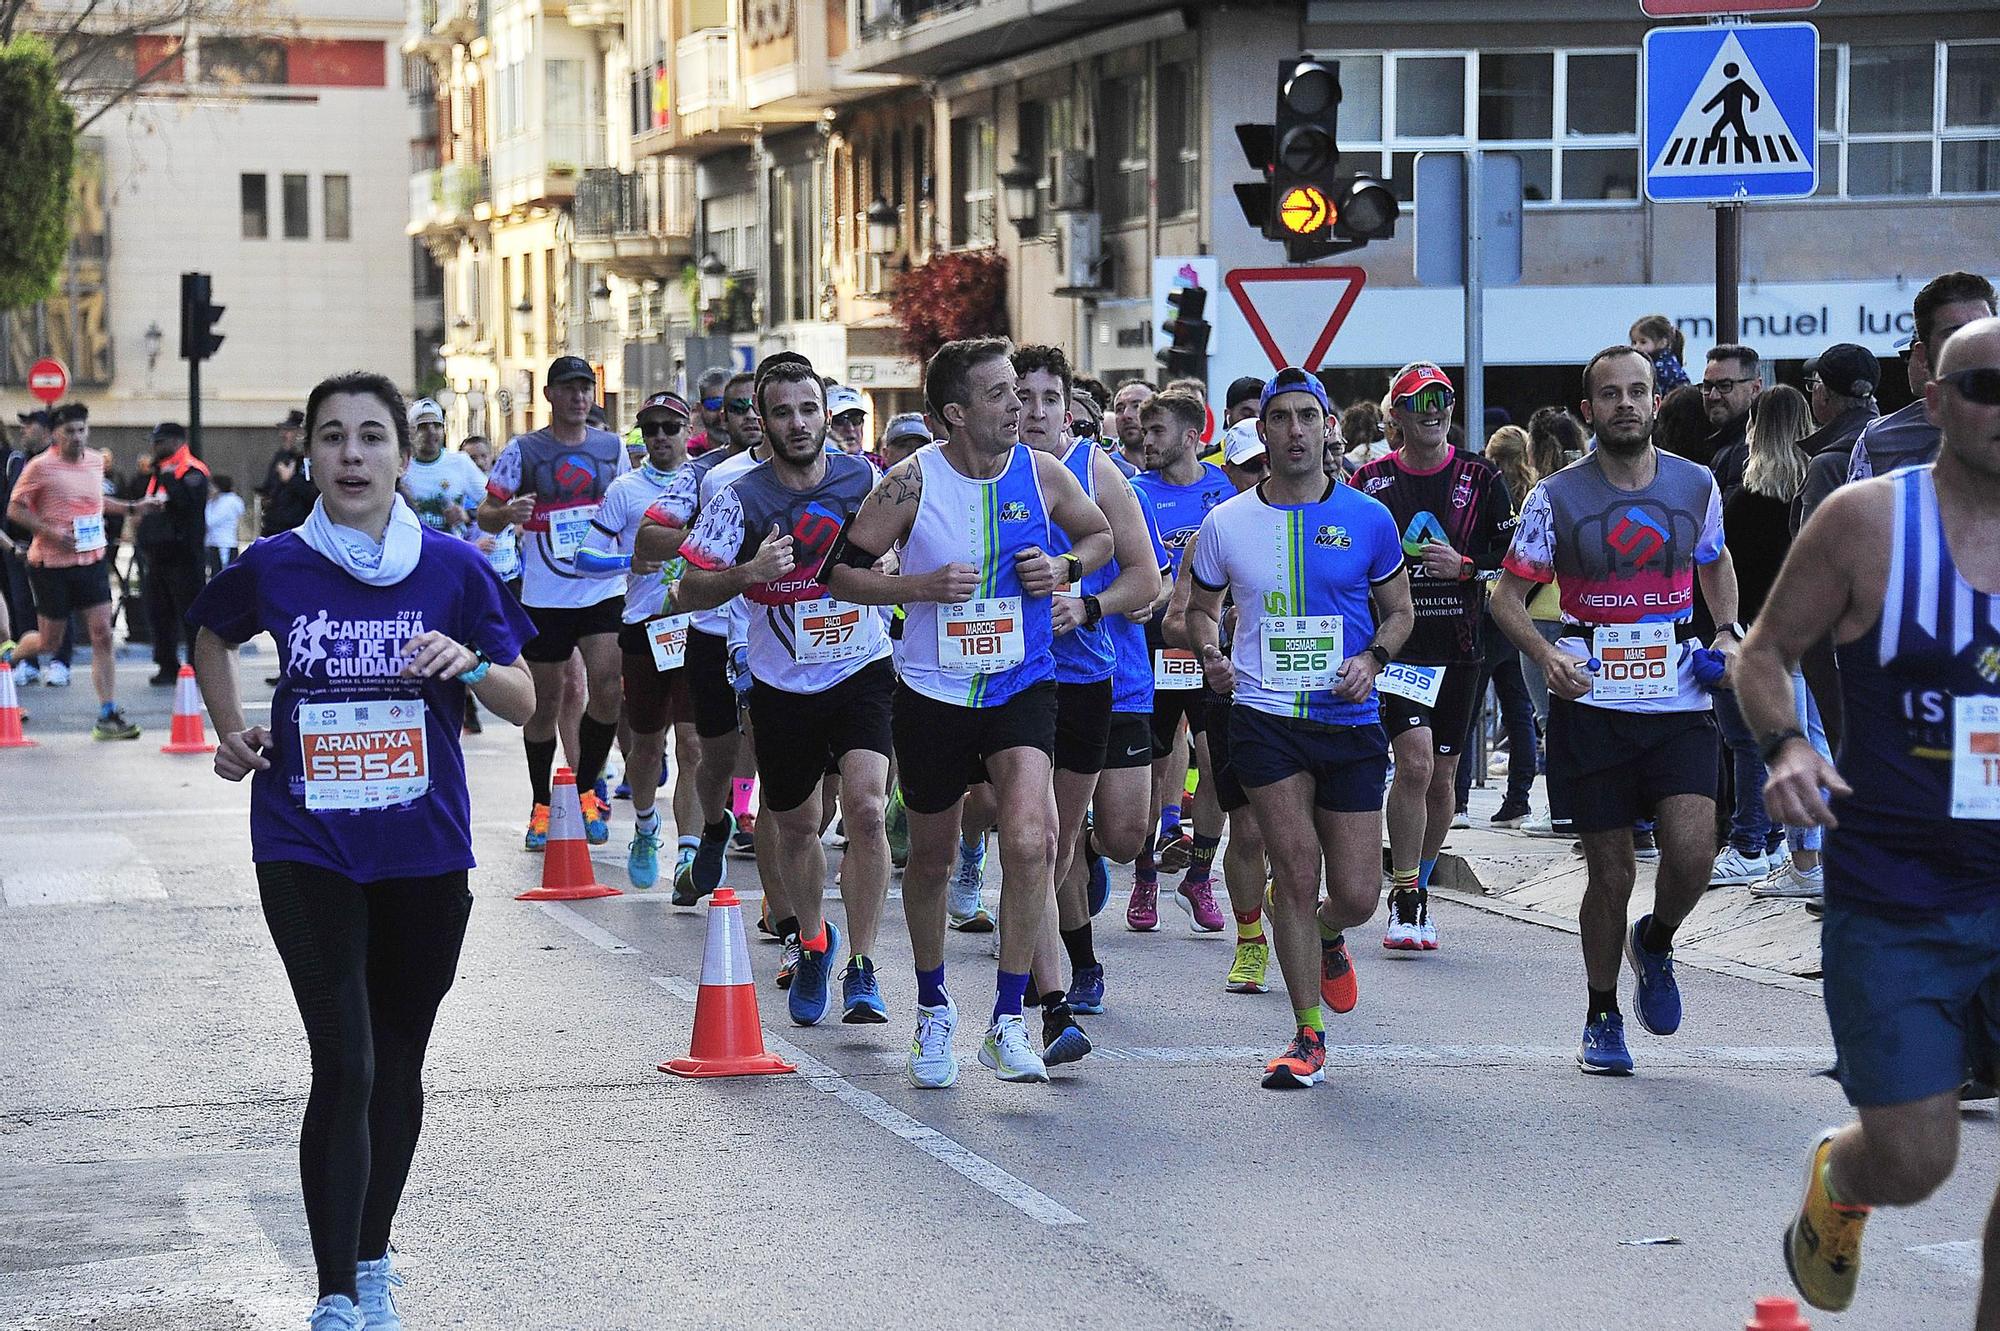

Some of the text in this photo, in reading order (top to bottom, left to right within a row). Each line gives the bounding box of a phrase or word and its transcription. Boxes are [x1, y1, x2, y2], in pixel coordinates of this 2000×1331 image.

[1677, 306, 1828, 337] mnuel
[766, 577, 819, 593] MEDIA
[1580, 586, 1691, 607] MEDIA ELCHE
[325, 620, 425, 640] CARRERA
[824, 616, 841, 628] PACO
[965, 623, 996, 634] MARCOS
[809, 626, 854, 647] 737
[960, 636, 1002, 656] 1181
[1285, 640, 1317, 650] ROSMARI
[359, 639, 386, 659] DE
[1276, 653, 1327, 671] 326
[1602, 661, 1666, 681] 1000
[1384, 666, 1431, 690] 1499
[314, 731, 412, 752] ARANTXA
[311, 751, 419, 780] 5354
